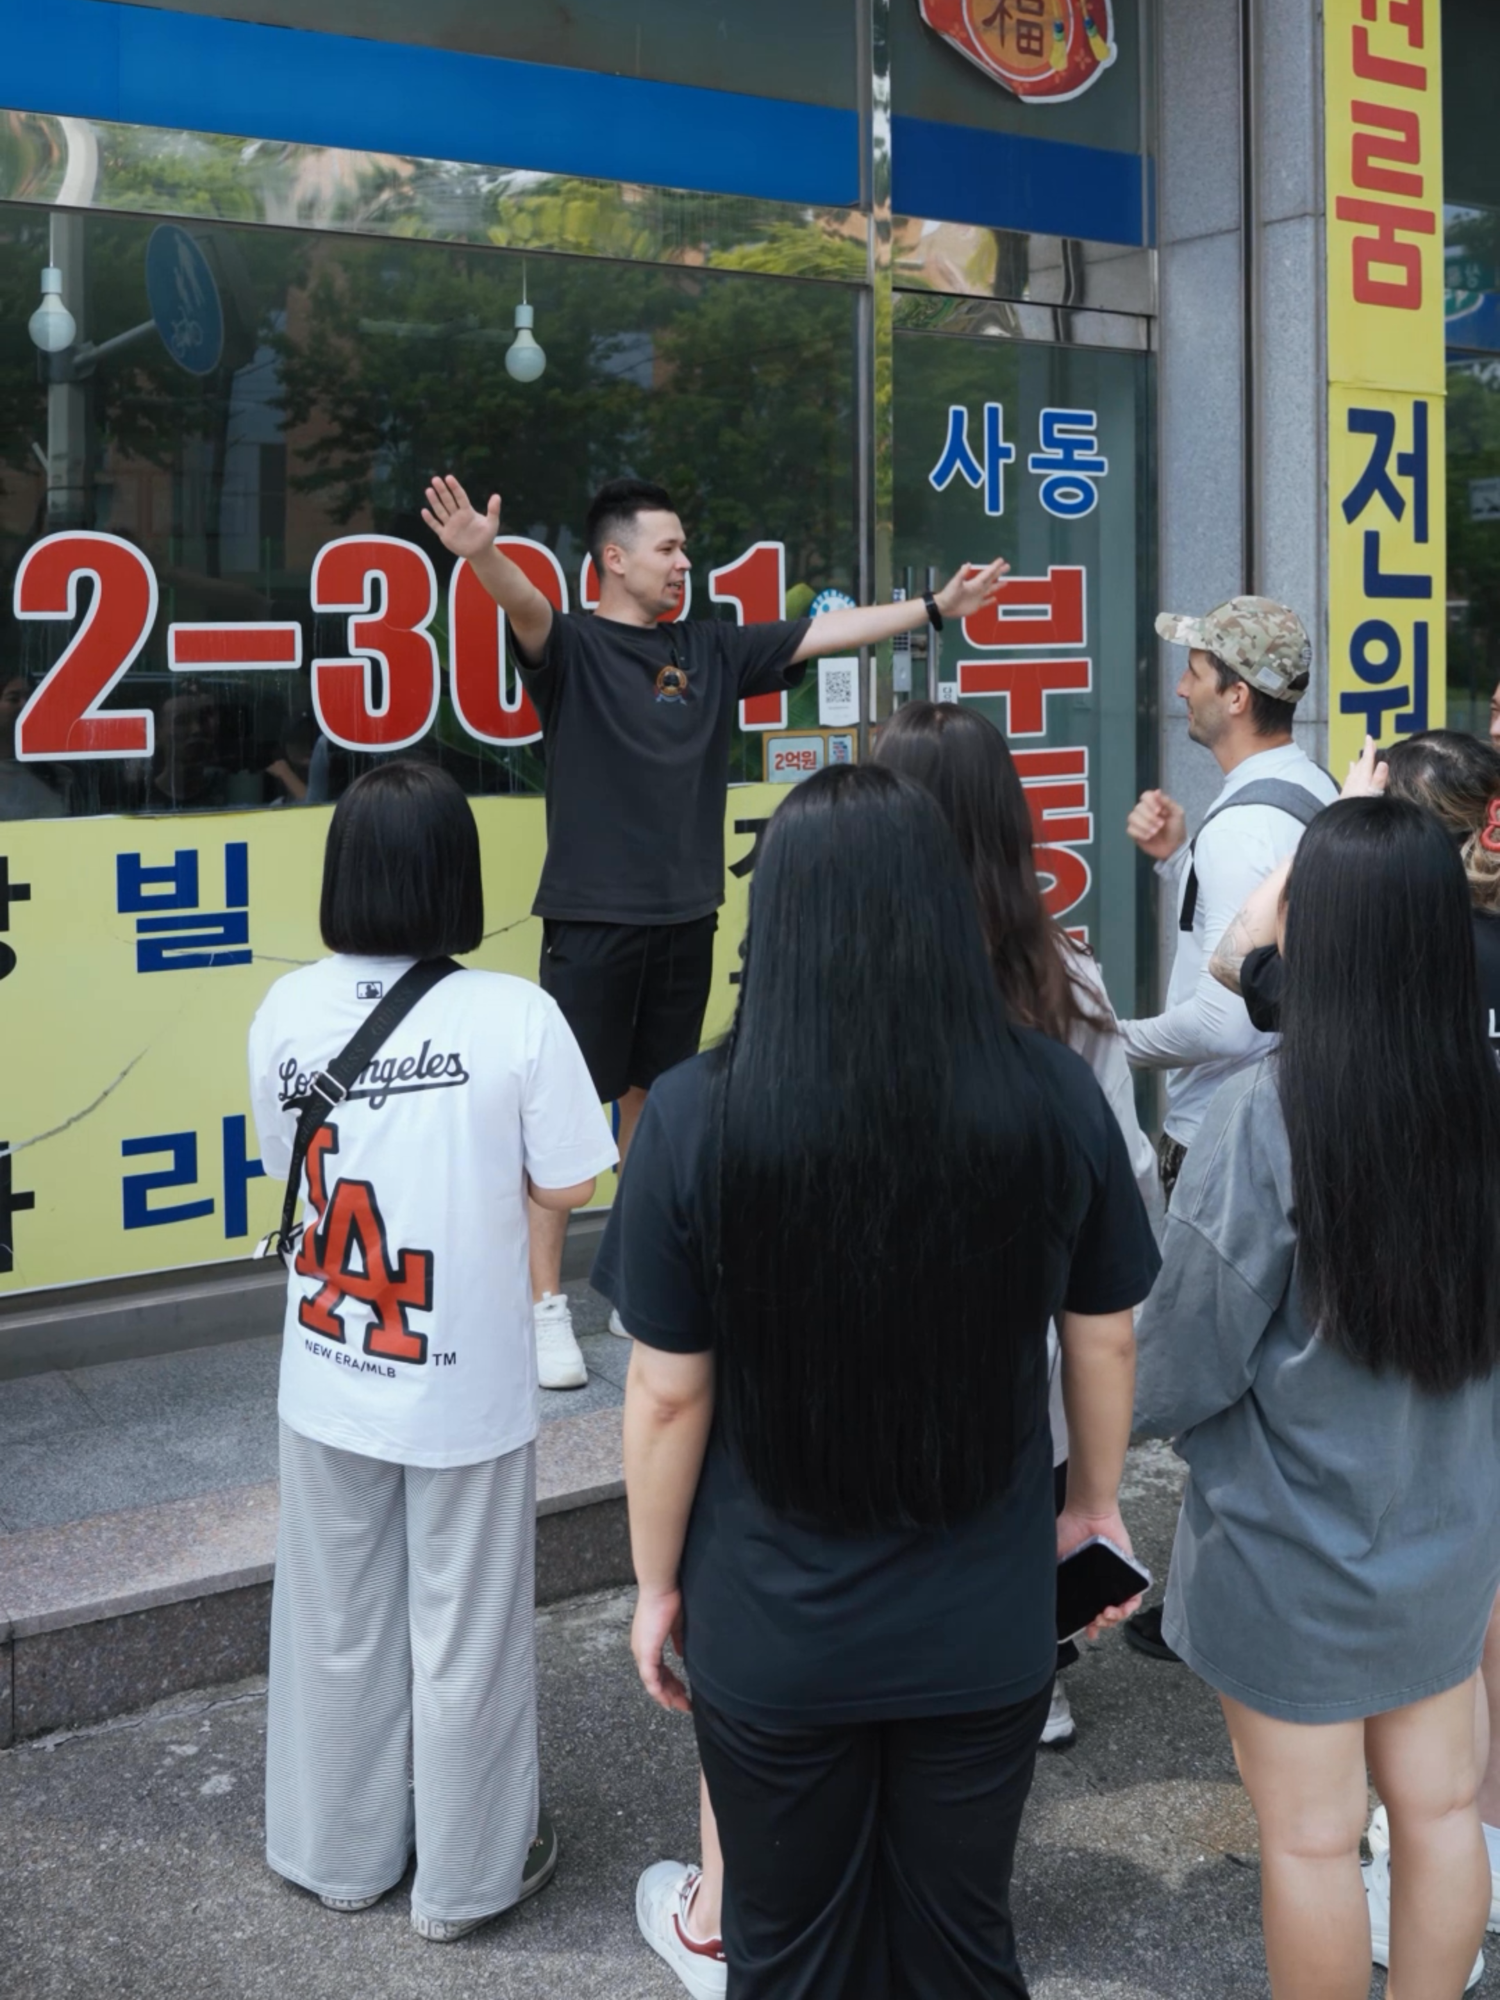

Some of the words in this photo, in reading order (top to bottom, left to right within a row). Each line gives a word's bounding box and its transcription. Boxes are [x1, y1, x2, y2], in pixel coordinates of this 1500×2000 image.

[929, 402, 1108, 519] 사동
[774, 749, 818, 771] 2억원
[357, 1039, 470, 1110] ngeles
[304, 1338, 332, 1360] NEW
[335, 1351, 397, 1379] ERA/MLB
[432, 1351, 457, 1367] TM
